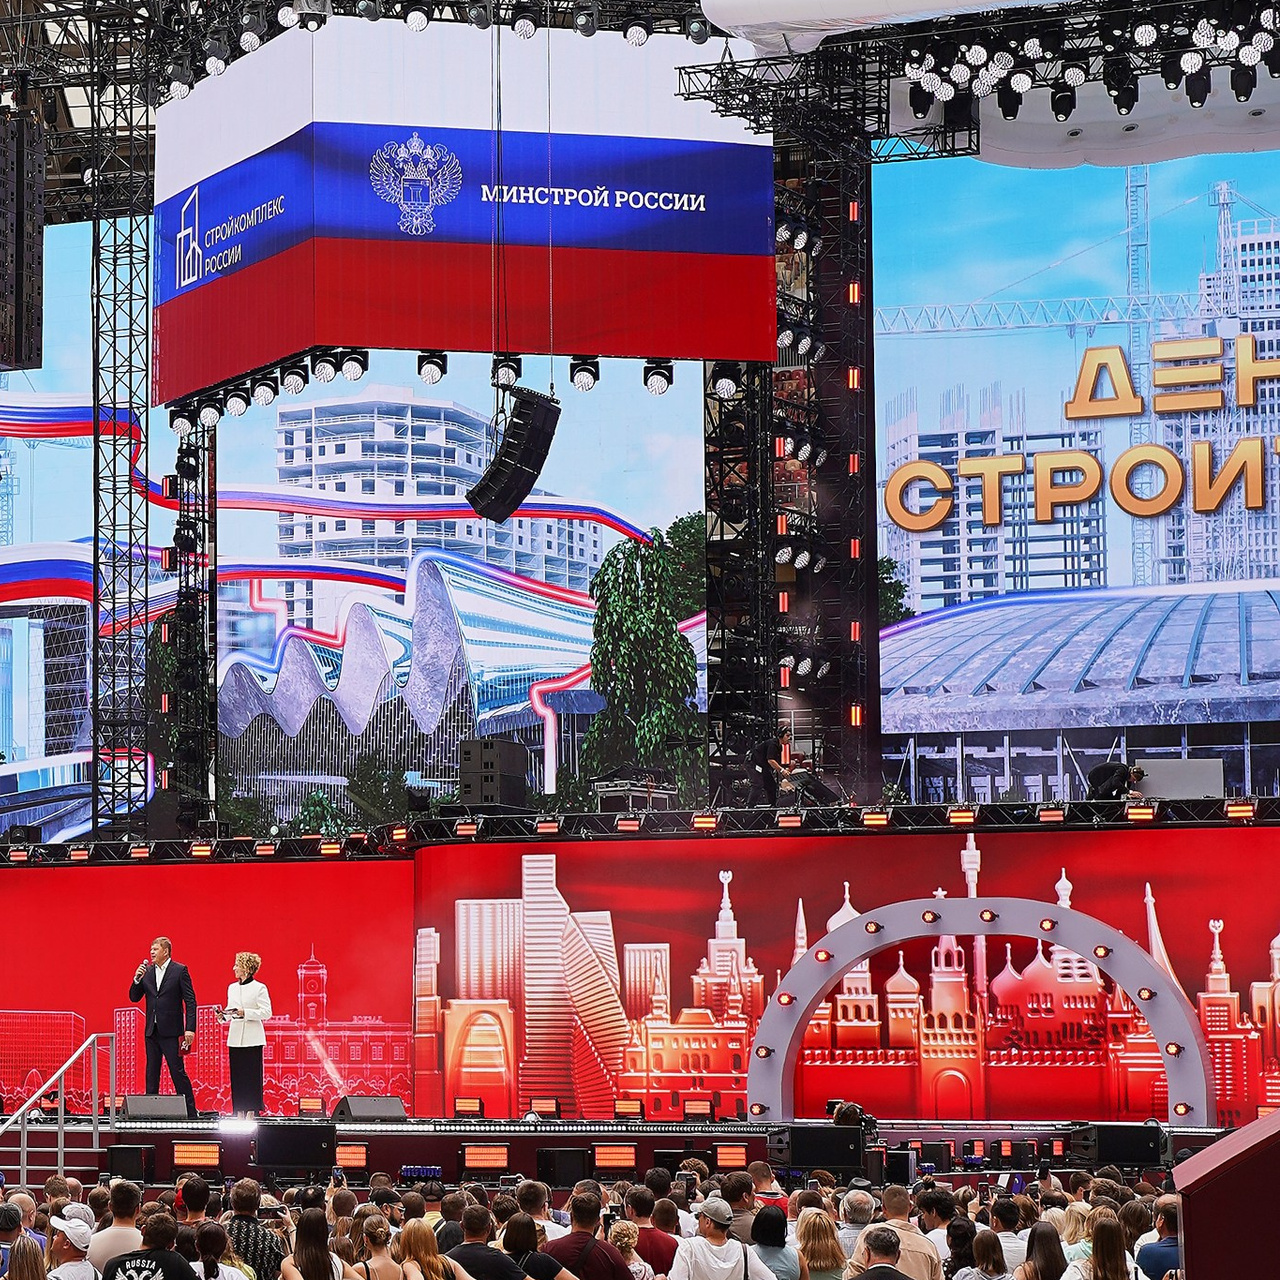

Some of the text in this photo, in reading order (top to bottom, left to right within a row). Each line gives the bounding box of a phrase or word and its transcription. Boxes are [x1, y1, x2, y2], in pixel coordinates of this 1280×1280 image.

[480, 184, 706, 212] МИНСТРОЙ РОССИИ
[204, 195, 285, 248] СТРОЙКОМПЛЕКС
[204, 243, 242, 276] РОССИИ
[884, 436, 1280, 533] СТРОИ
[125, 1259, 157, 1270] RUSSIA
